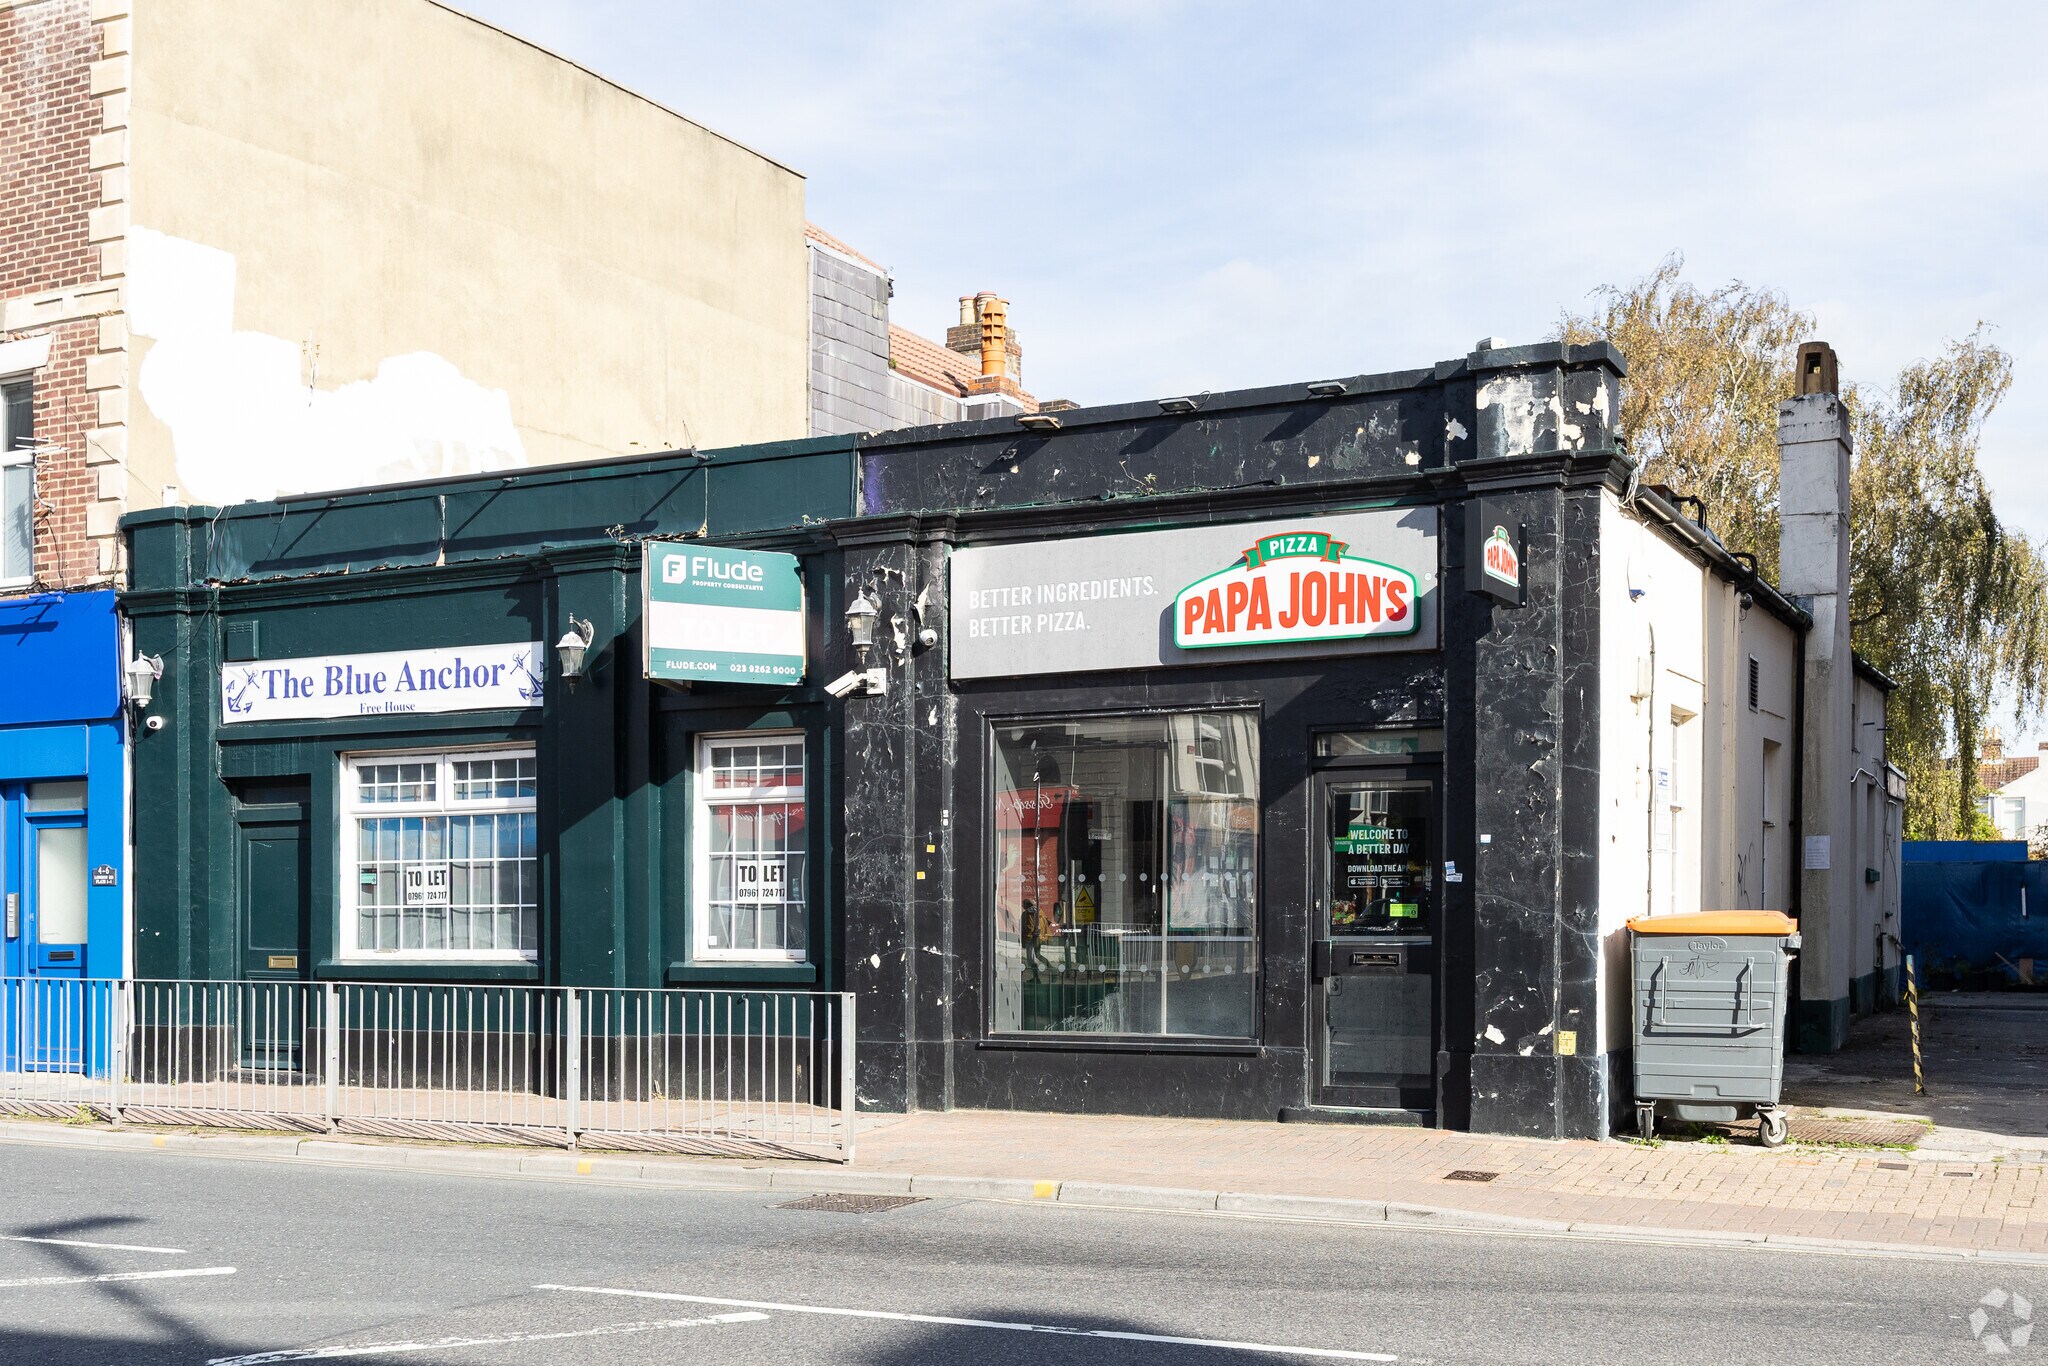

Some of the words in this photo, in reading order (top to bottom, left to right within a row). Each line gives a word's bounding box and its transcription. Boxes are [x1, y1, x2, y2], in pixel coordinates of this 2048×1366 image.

[1269, 536, 1318, 556] PIZZA
[692, 556, 764, 582] Flude
[692, 580, 722, 588] PROPERTY
[723, 582, 764, 591] CONSULTANTS
[969, 585, 1032, 610] BETTER
[1037, 575, 1159, 604] INGREDIENTS.
[1184, 575, 1272, 635] PAPA
[1278, 570, 1408, 629] JOHN'S
[969, 614, 1032, 638] BETTER
[1037, 611, 1091, 633] PIZZA.
[666, 660, 717, 671] FLUDE.COM
[730, 664, 747, 673] 023
[749, 664, 771, 674] 9262
[773, 665, 796, 675] 9000
[261, 668, 314, 700] The
[323, 664, 387, 697] Blue
[394, 657, 506, 693] Anchor
[360, 703, 381, 714] Free
[385, 701, 416, 713] House
[1350, 829, 1395, 840] WELCOME
[1396, 828, 1408, 839] TO
[1348, 844, 1354, 855] A
[1356, 843, 1391, 854] BETTER
[1393, 843, 1410, 854] DAY
[98, 866, 109, 874] 4-6
[739, 865, 757, 882] TO
[763, 865, 785, 882] LET
[1347, 864, 1383, 873] DOWNLOAD
[1384, 864, 1396, 872] THE
[408, 870, 422, 887] TO
[428, 870, 447, 886] LET
[427, 892, 437, 900] 724
[739, 888, 759, 897] 07961
[762, 888, 774, 897] 724
[775, 888, 785, 897] 717
[1693, 940, 1724, 952] Taylor
